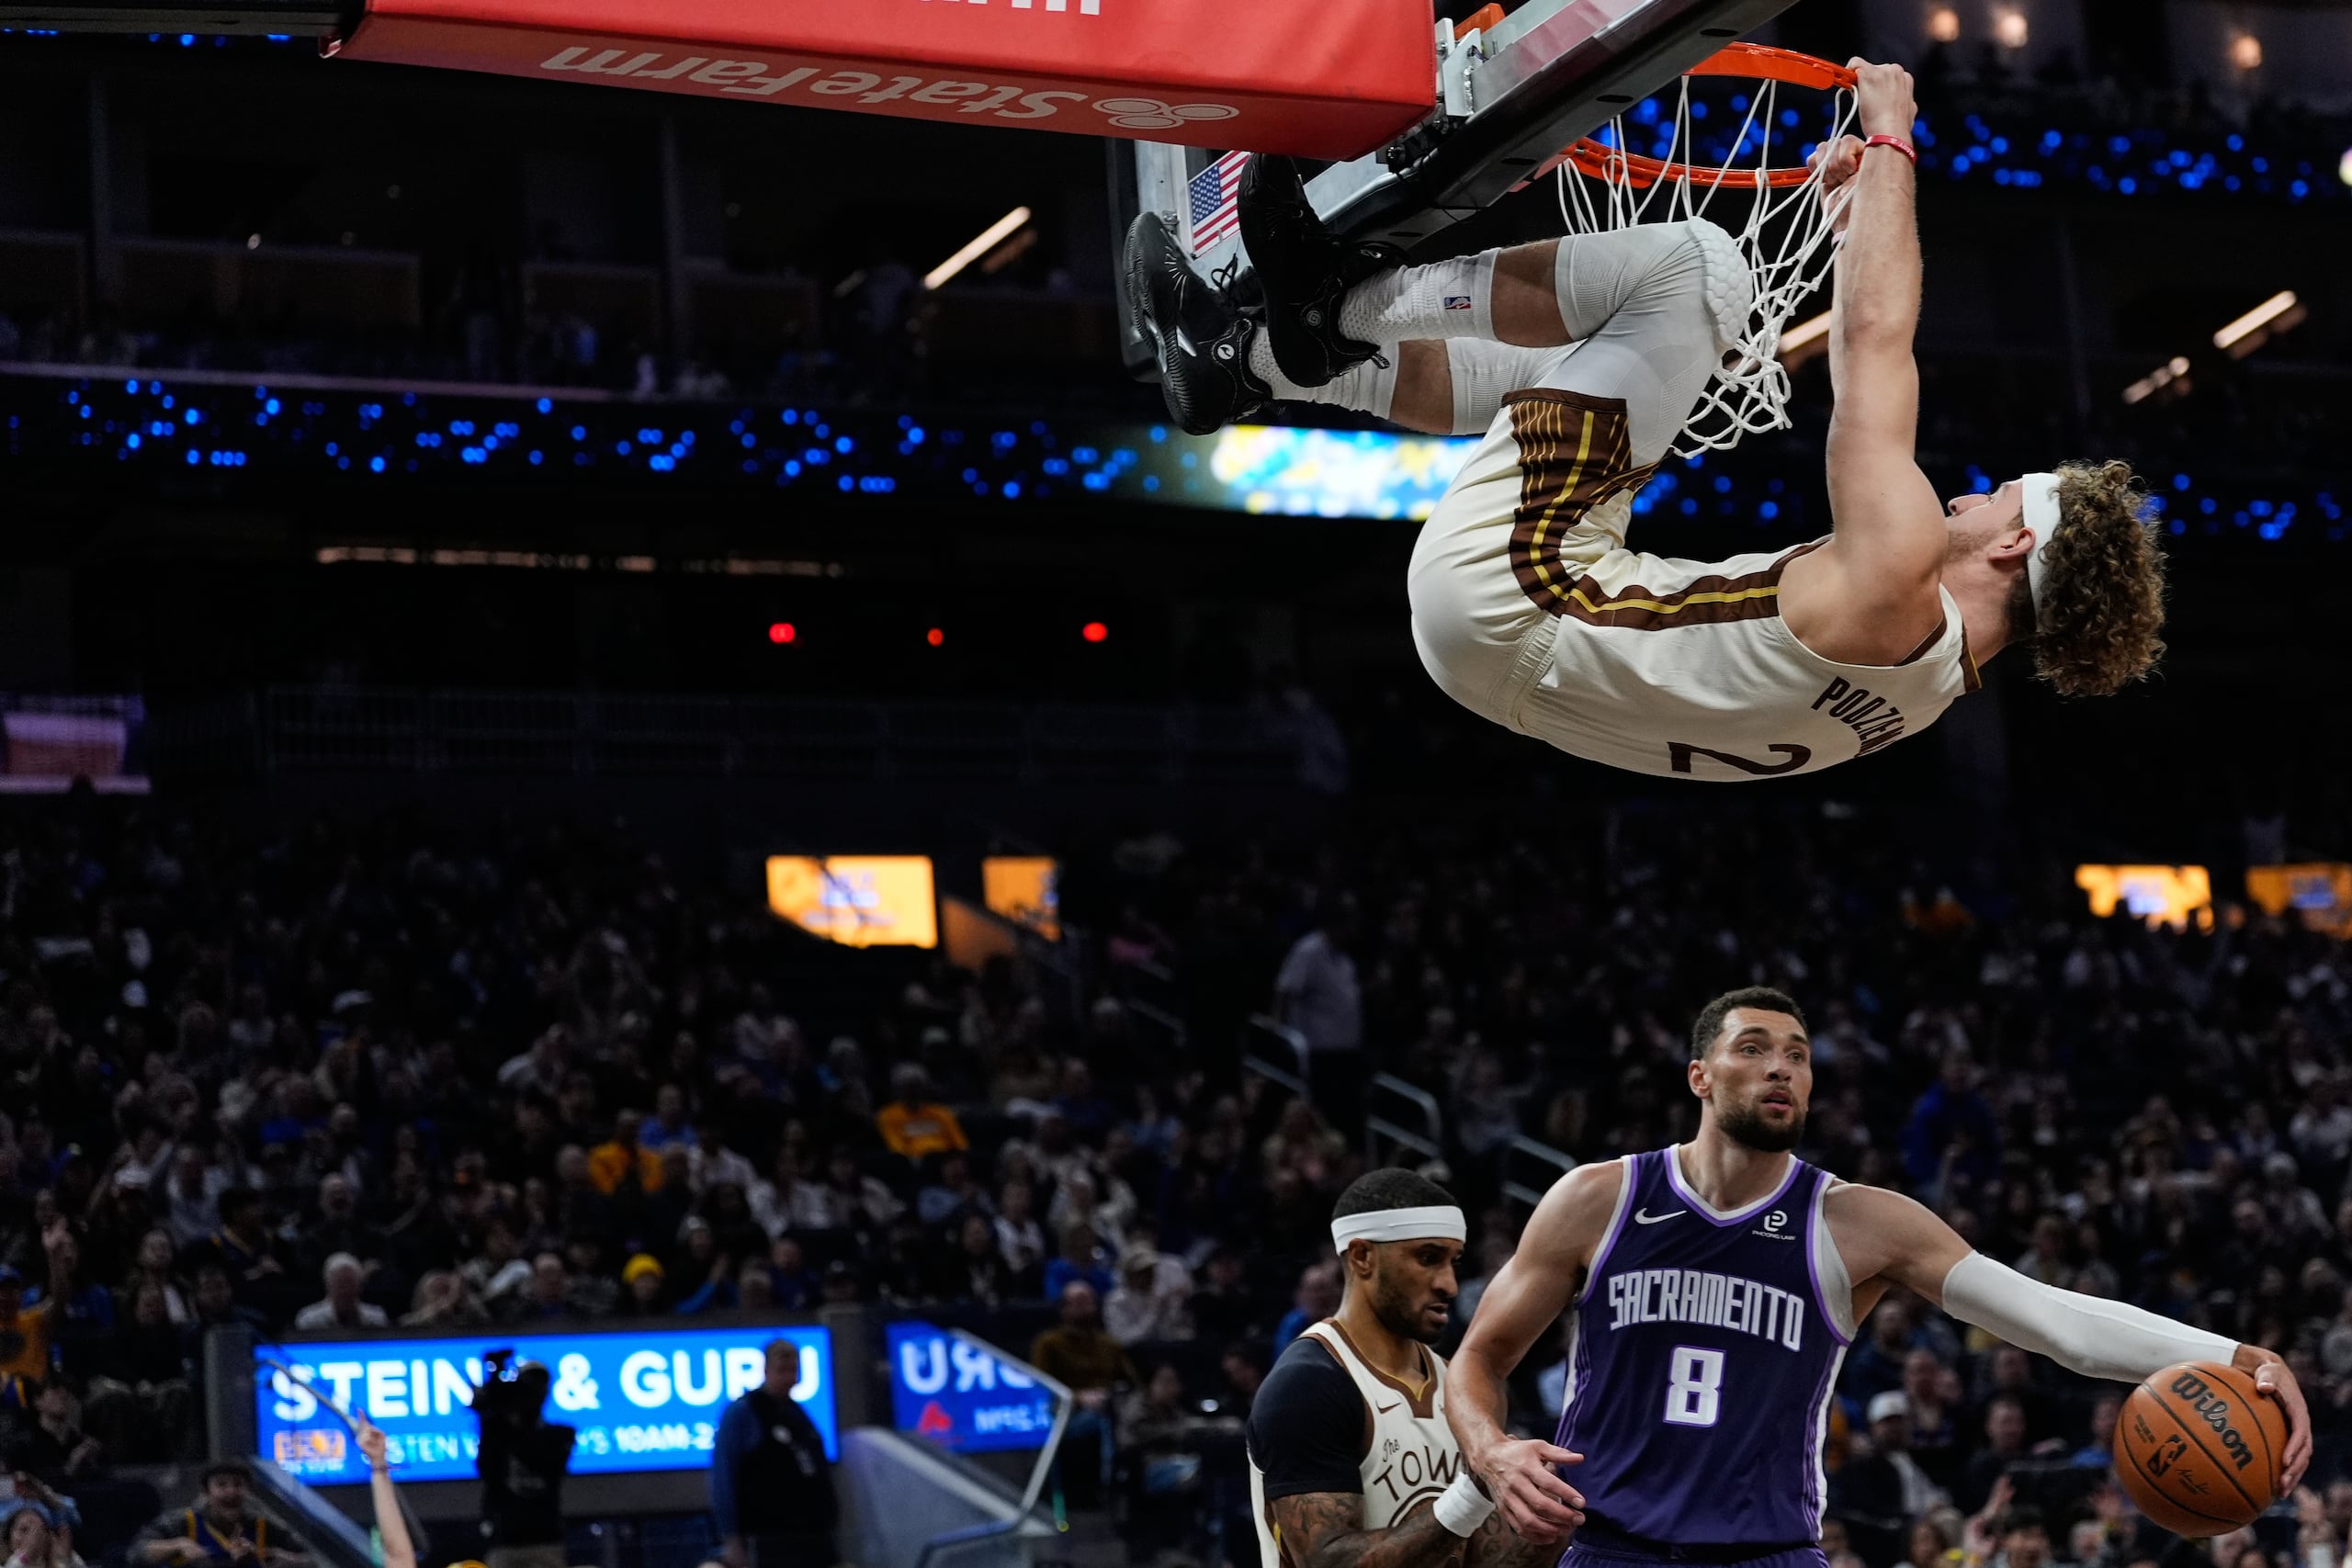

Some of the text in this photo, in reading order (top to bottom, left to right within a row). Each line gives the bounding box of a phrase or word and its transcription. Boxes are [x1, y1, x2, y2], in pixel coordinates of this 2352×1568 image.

[1666, 740, 1812, 775] 2
[1608, 1267, 1805, 1352] SACRAMENTO
[272, 1357, 484, 1421] STEIN
[552, 1351, 602, 1412] &
[1661, 1344, 1728, 1428] 8
[614, 1423, 720, 1453] 10AM-2
[1382, 1438, 1401, 1463] The
[2170, 1371, 2254, 1471] Wilson
[1373, 1444, 1462, 1502] TOW
